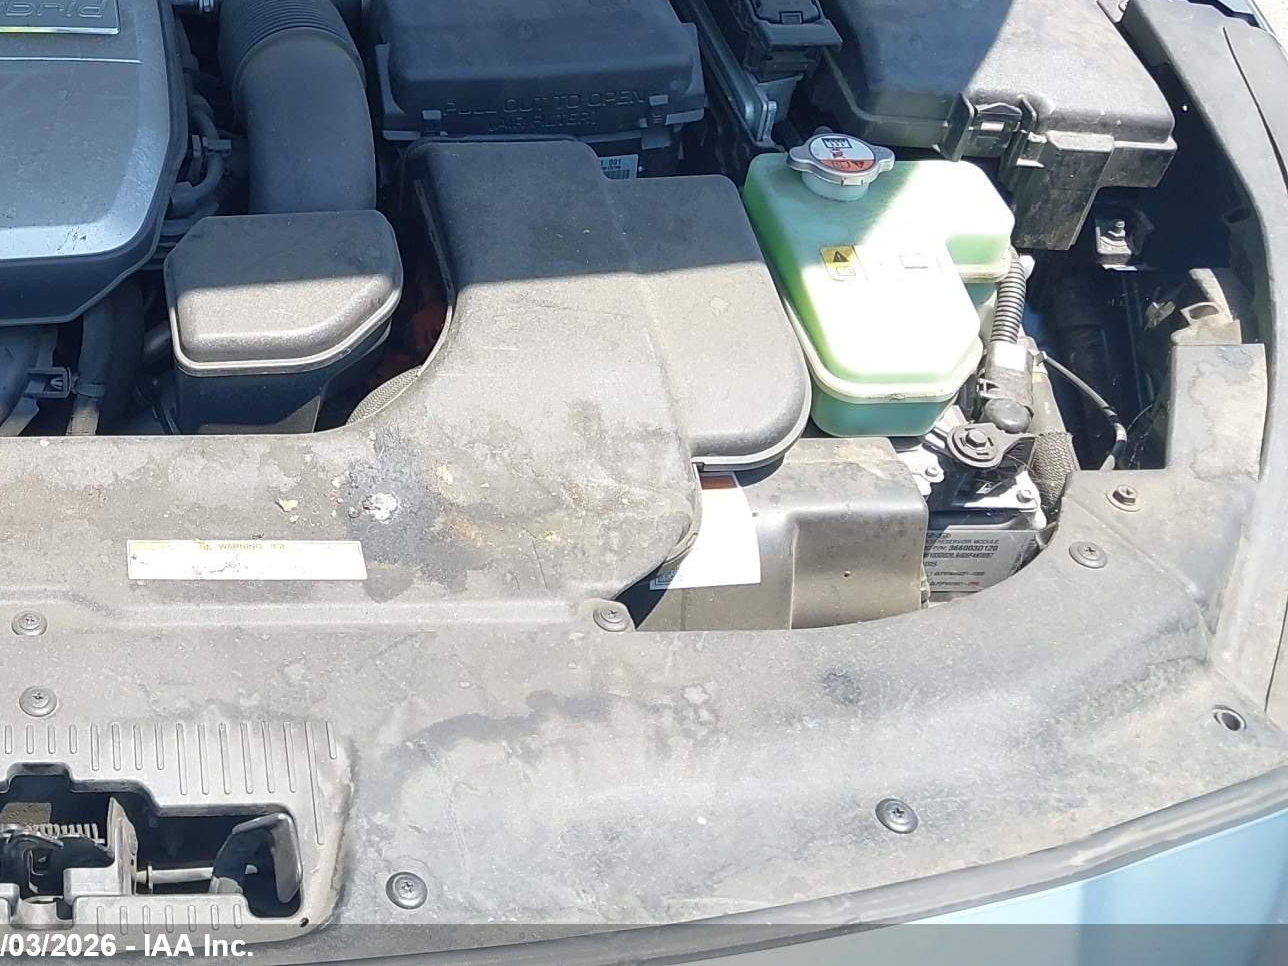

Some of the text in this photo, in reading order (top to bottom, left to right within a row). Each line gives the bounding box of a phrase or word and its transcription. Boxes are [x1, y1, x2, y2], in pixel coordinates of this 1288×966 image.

[503, 97, 548, 113] OUT
[552, 95, 581, 110] TO
[586, 90, 645, 107] OPEN
